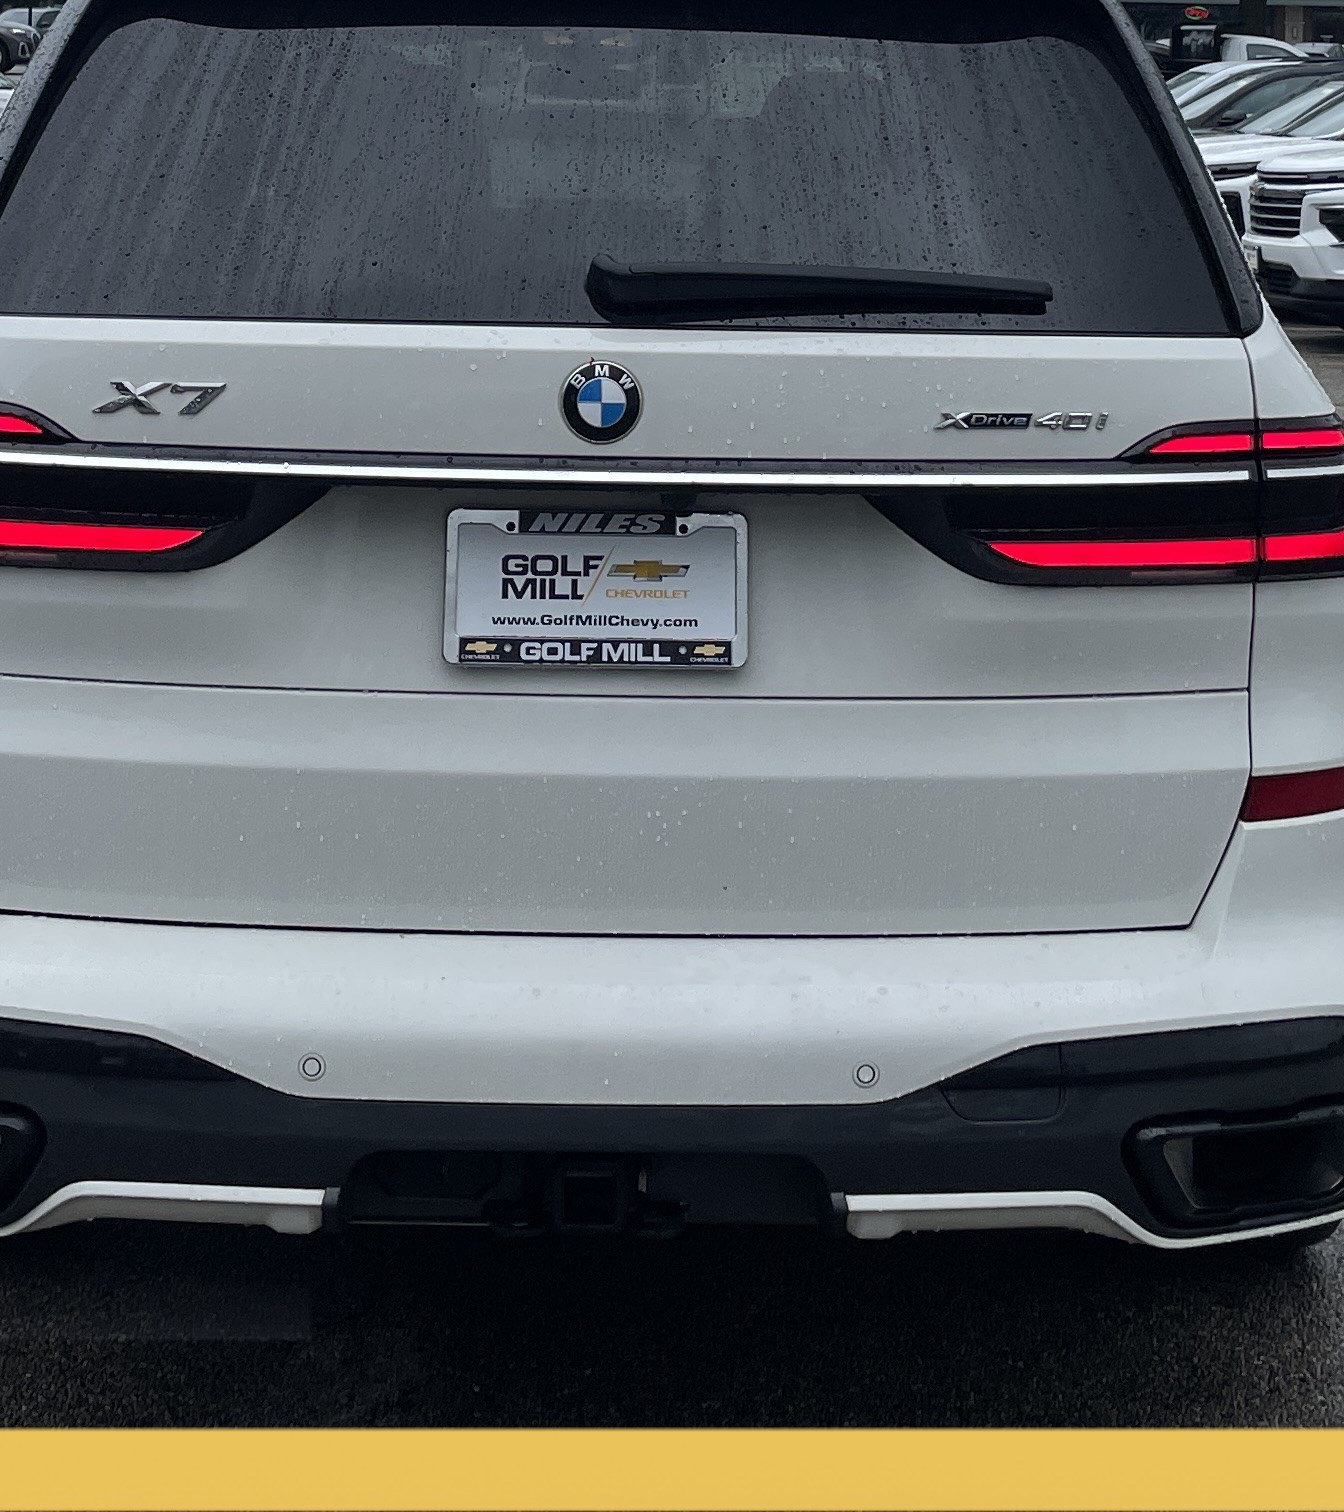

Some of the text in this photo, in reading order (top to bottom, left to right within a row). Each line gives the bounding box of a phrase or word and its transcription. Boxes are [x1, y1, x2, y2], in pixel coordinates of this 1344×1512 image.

[570, 365, 635, 390] BMW
[92, 381, 227, 415] X7
[528, 513, 666, 534] NILES
[501, 554, 605, 577] GOLF
[501, 578, 584, 600] MILL
[606, 589, 690, 599] CHEVROLET
[492, 614, 698, 629] www.GolfMillChevy.com
[520, 641, 671, 662] GOLF MILL
